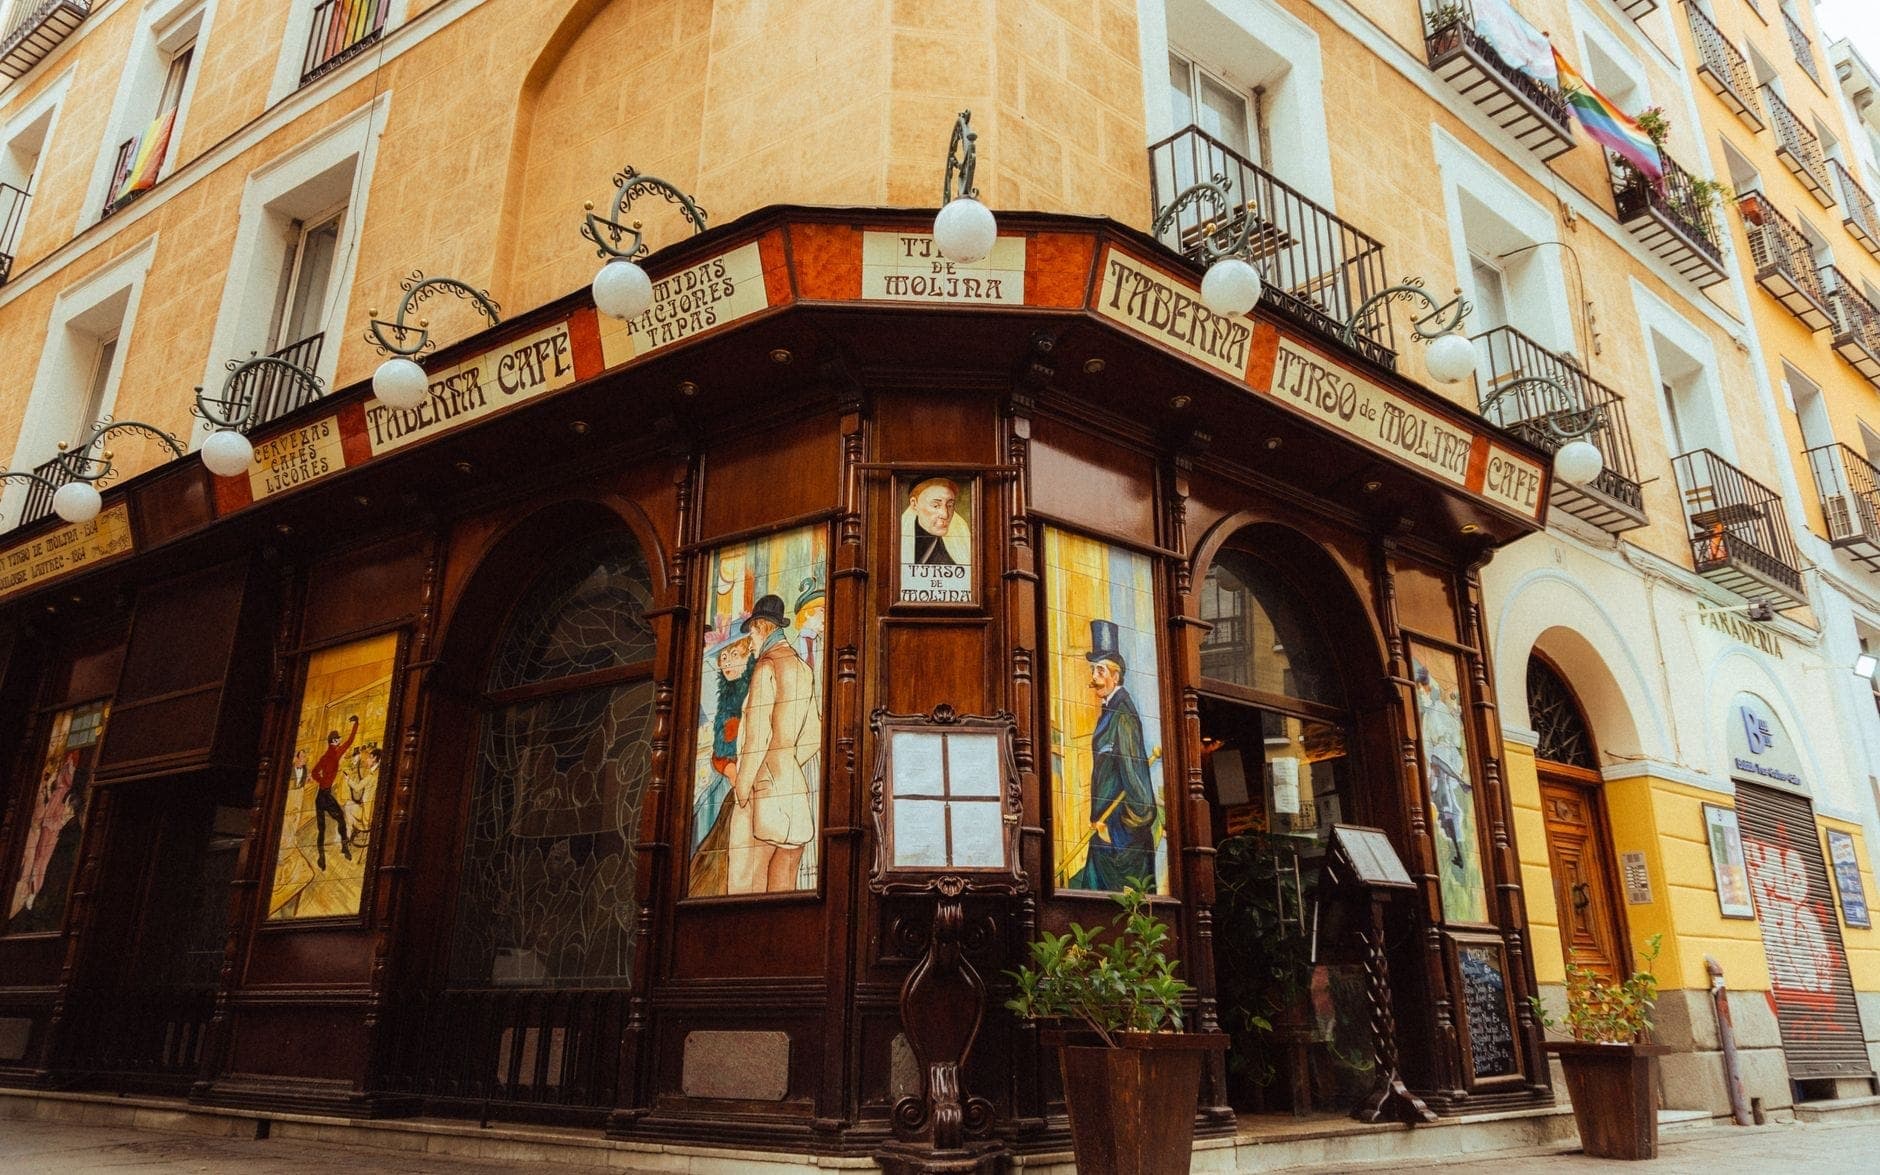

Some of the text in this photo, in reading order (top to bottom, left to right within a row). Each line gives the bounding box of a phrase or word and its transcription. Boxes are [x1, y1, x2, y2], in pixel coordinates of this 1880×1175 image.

[931, 261, 956, 275] DE
[884, 275, 1002, 299] MOLINA
[1109, 259, 1250, 370] TABERNA
[646, 306, 718, 347] TAPAS
[1277, 344, 1472, 479] TIRSO de MOLINA
[265, 457, 329, 495] LICORES
[32, 543, 43, 558] DE
[908, 565, 966, 579] TIRSO
[930, 579, 943, 588] DE
[901, 589, 971, 602] MOLINA
